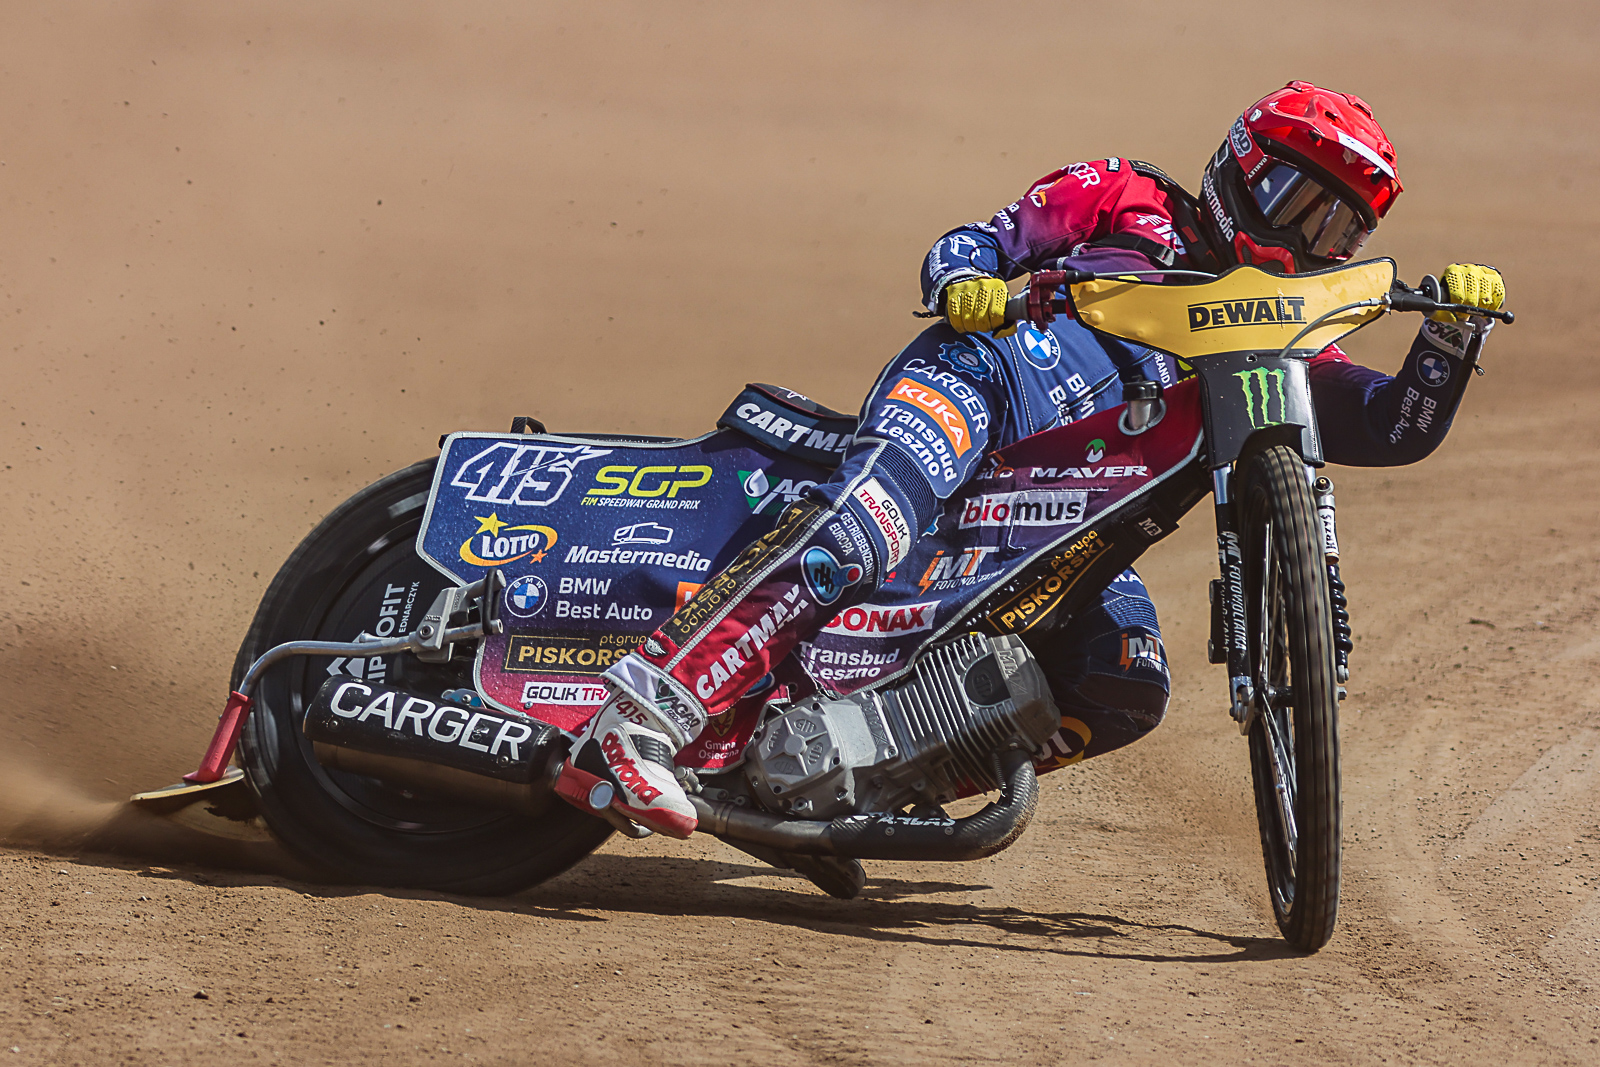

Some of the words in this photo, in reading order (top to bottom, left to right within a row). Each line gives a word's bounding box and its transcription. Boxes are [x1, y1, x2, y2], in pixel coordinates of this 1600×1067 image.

[1235, 116, 1252, 153] GAD
[1248, 157, 1268, 179] OAKLEY
[902, 358, 989, 433] CARGER
[1400, 386, 1420, 418] Best
[897, 384, 964, 449] KUKA
[1416, 396, 1437, 433] BMW
[875, 418, 940, 477] Leszno
[879, 404, 957, 483] Transbud
[586, 465, 713, 498] SGP
[1030, 465, 1148, 479] MAVER
[580, 497, 598, 506] FIM
[597, 497, 647, 508] SPEEDWAY
[646, 499, 679, 509] GRAND
[678, 500, 700, 510] PRIX
[962, 500, 1083, 525] biomus
[860, 489, 900, 565] TRANSPORT
[882, 500, 907, 540] GOLIK
[481, 532, 540, 559] LOTTO
[829, 522, 855, 556] EUROPA
[564, 545, 712, 572] Mastermedia
[513, 577, 545, 590] BMW
[559, 577, 612, 595] BMW
[1000, 538, 1105, 630] PISKORSKI
[399, 581, 420, 633] EDNARCZYK
[556, 601, 600, 619] Best
[605, 602, 653, 621] Auto
[1229, 564, 1247, 651] FOTOWOLTAIKA
[599, 634, 647, 647] pt.grup
[807, 660, 881, 681] Leszno
[526, 686, 579, 700] GOLIK
[330, 682, 533, 761] CARGER
[698, 749, 740, 760] Osieczna
[705, 740, 736, 750] Gmina
